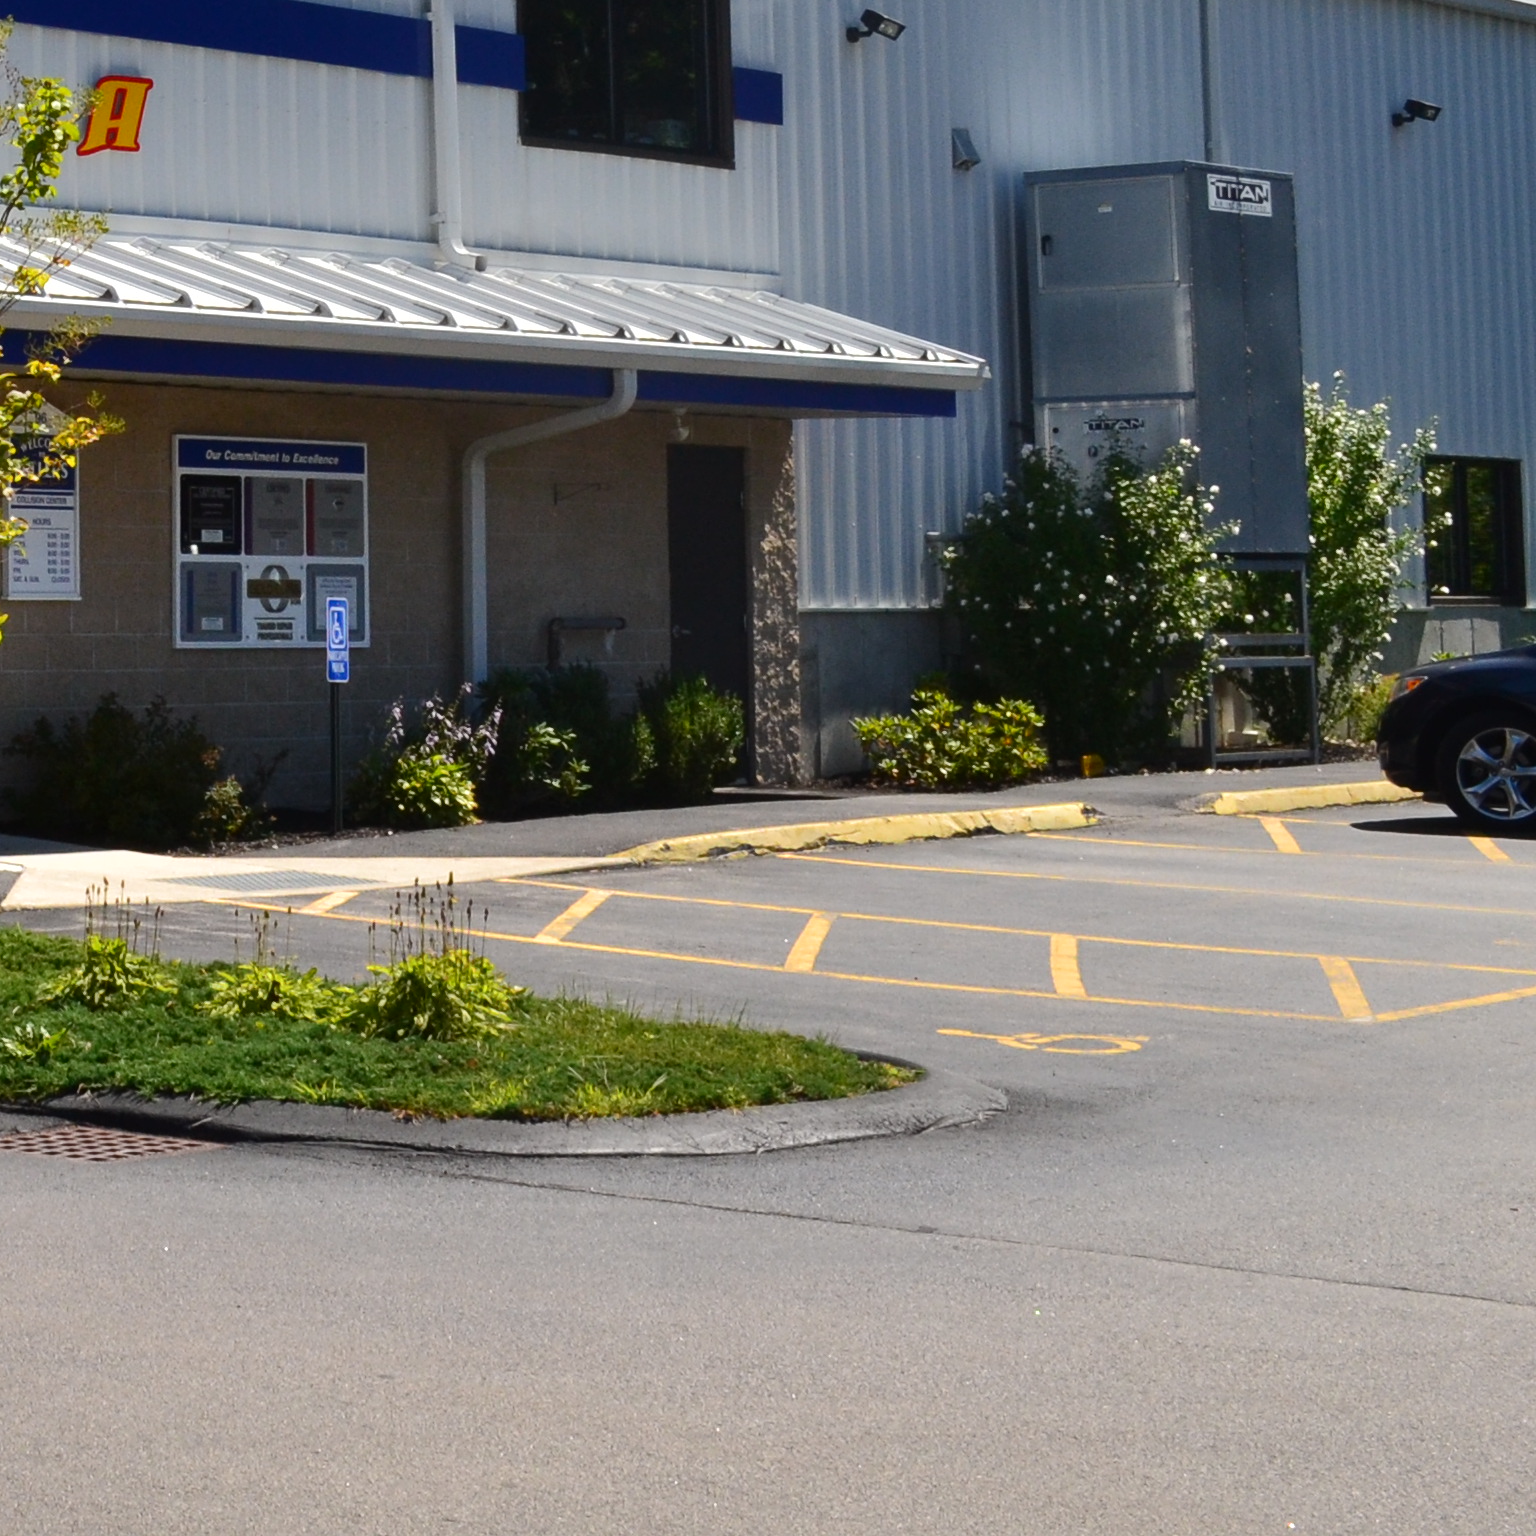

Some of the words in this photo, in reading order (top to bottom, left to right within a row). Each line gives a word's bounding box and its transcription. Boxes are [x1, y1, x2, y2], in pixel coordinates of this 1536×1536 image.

[1211, 180, 1269, 203] TITAN
[1084, 418, 1145, 431] TITAN
[206, 449, 221, 460] Our
[224, 450, 279, 462] Commitment
[282, 451, 290, 462] to
[293, 453, 339, 465] Excellence
